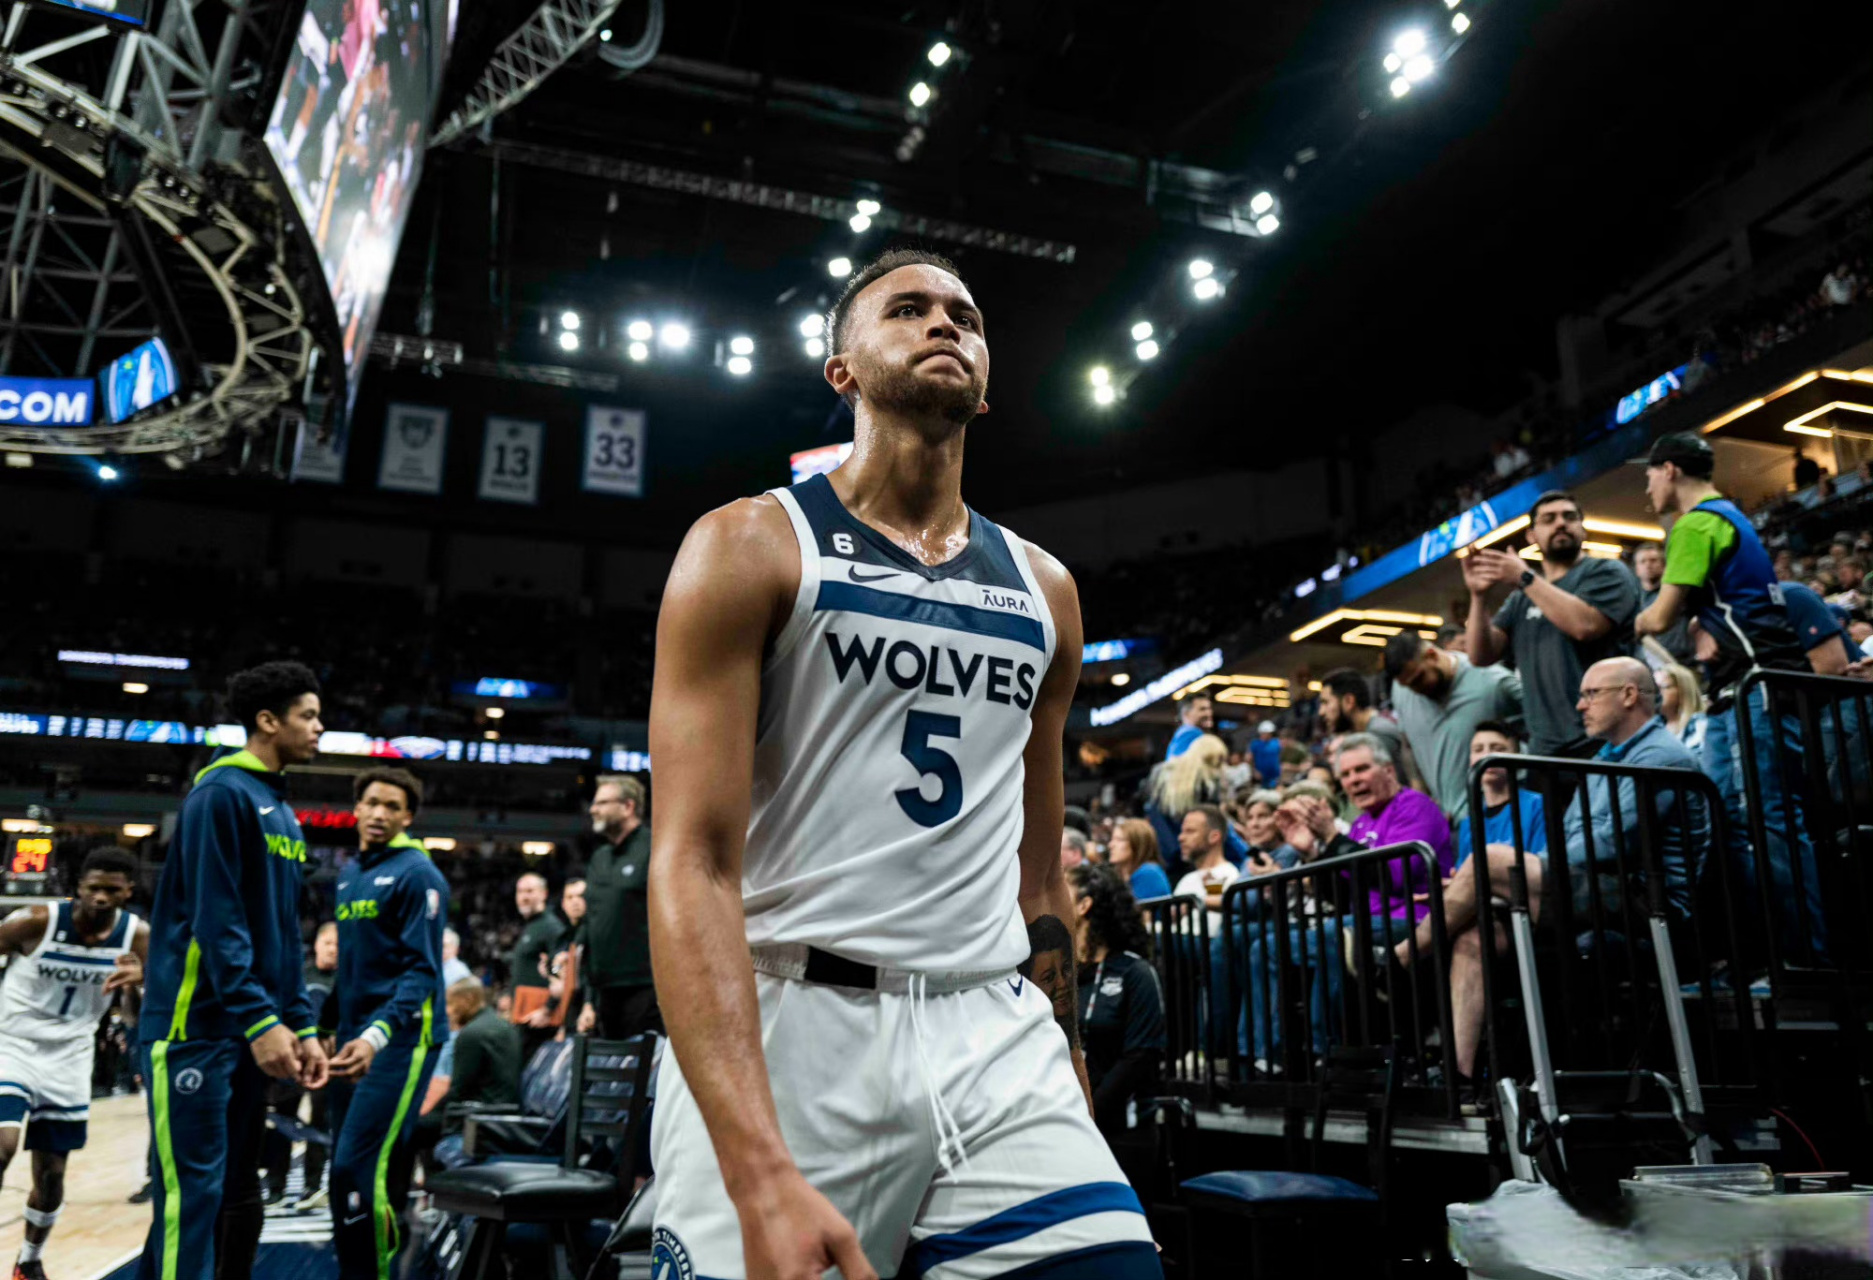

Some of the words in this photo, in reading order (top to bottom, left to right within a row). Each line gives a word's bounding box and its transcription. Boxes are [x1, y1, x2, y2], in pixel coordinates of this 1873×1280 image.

[0, 389, 87, 423] COM
[494, 444, 529, 477] 13
[594, 433, 636, 470] 33
[832, 532, 855, 555] 6
[825, 632, 1036, 711] WOLVES
[894, 708, 963, 828] 5
[13, 851, 47, 873] 24
[38, 963, 108, 986] WOLVE
[59, 985, 78, 1016] 1
